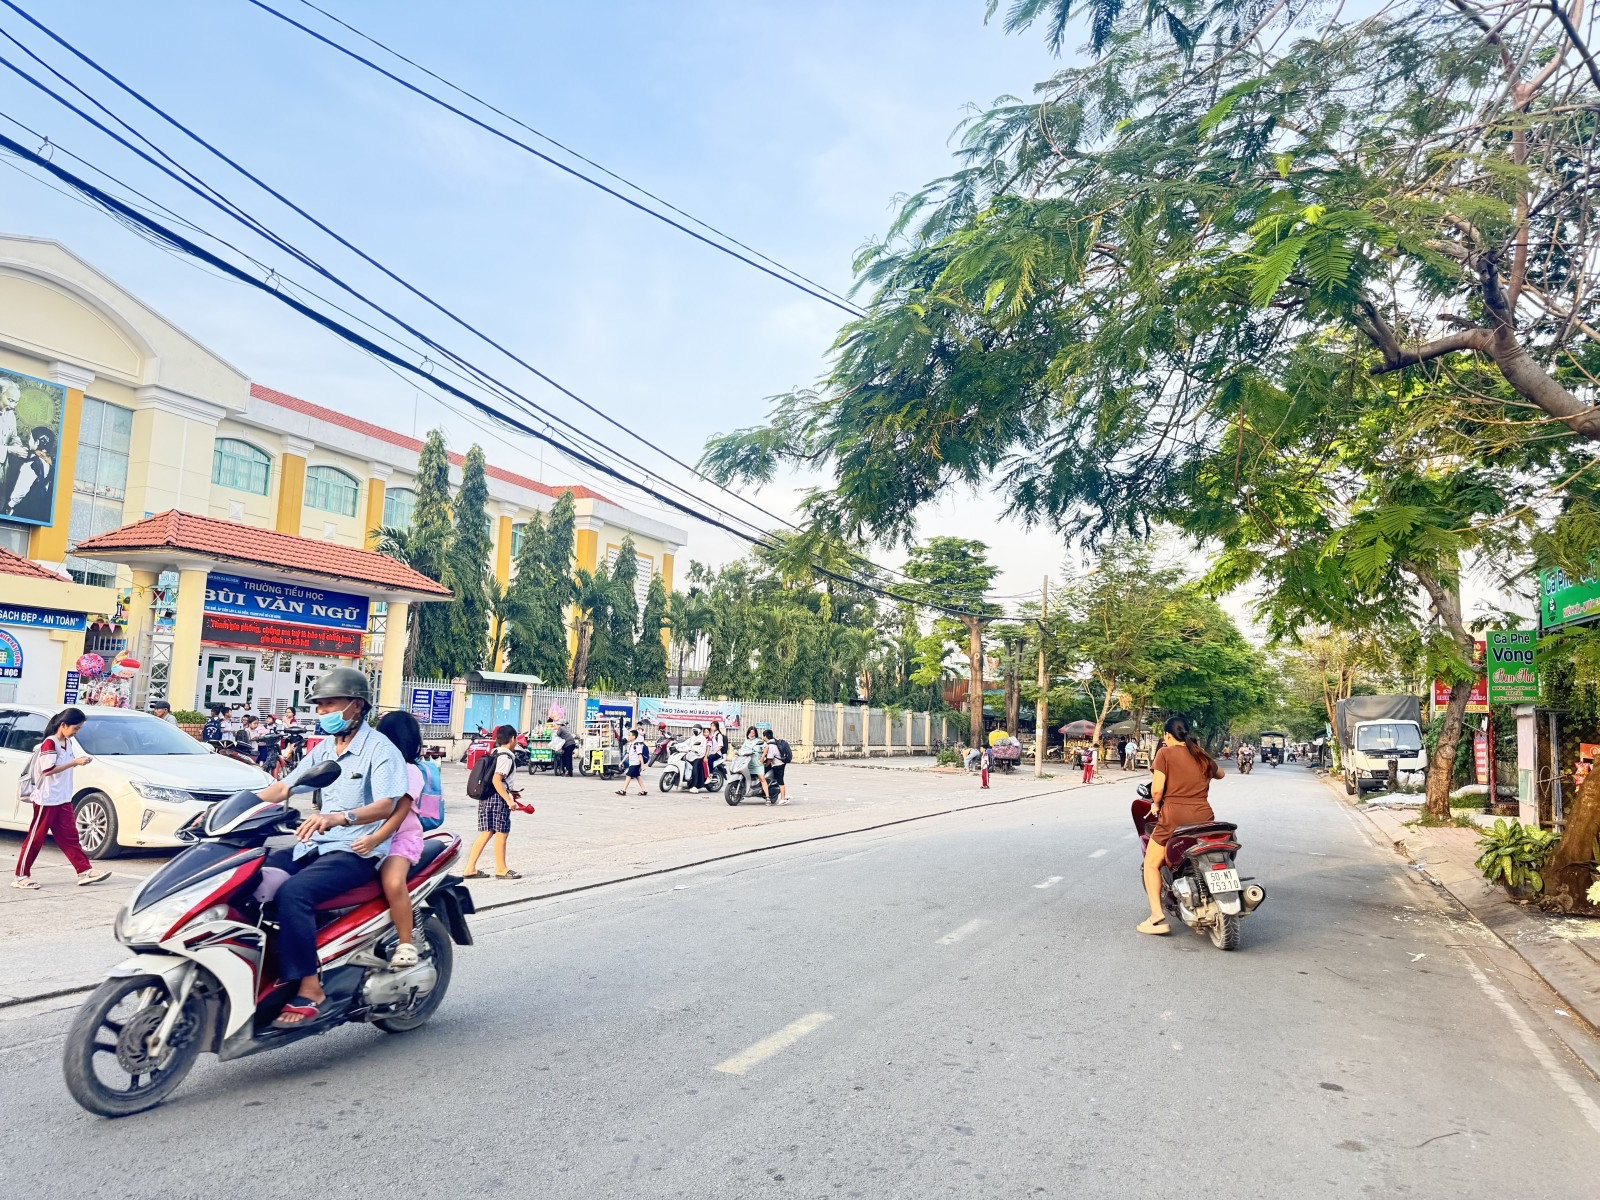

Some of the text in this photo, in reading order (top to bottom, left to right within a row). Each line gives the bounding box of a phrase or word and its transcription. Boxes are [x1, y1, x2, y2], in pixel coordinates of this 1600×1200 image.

[243, 581, 324, 601] TRƯỜNG TIỂU HỌC
[205, 587, 360, 621] BÙI VĂN NGỮ
[21, 612, 37, 623] ĐẸP
[43, 614, 54, 624] AN
[1493, 632, 1531, 644] Cà Phê
[1491, 647, 1534, 665] Võng
[4, 668, 19, 677] HỌC
[1210, 880, 1239, 891] 753.10
